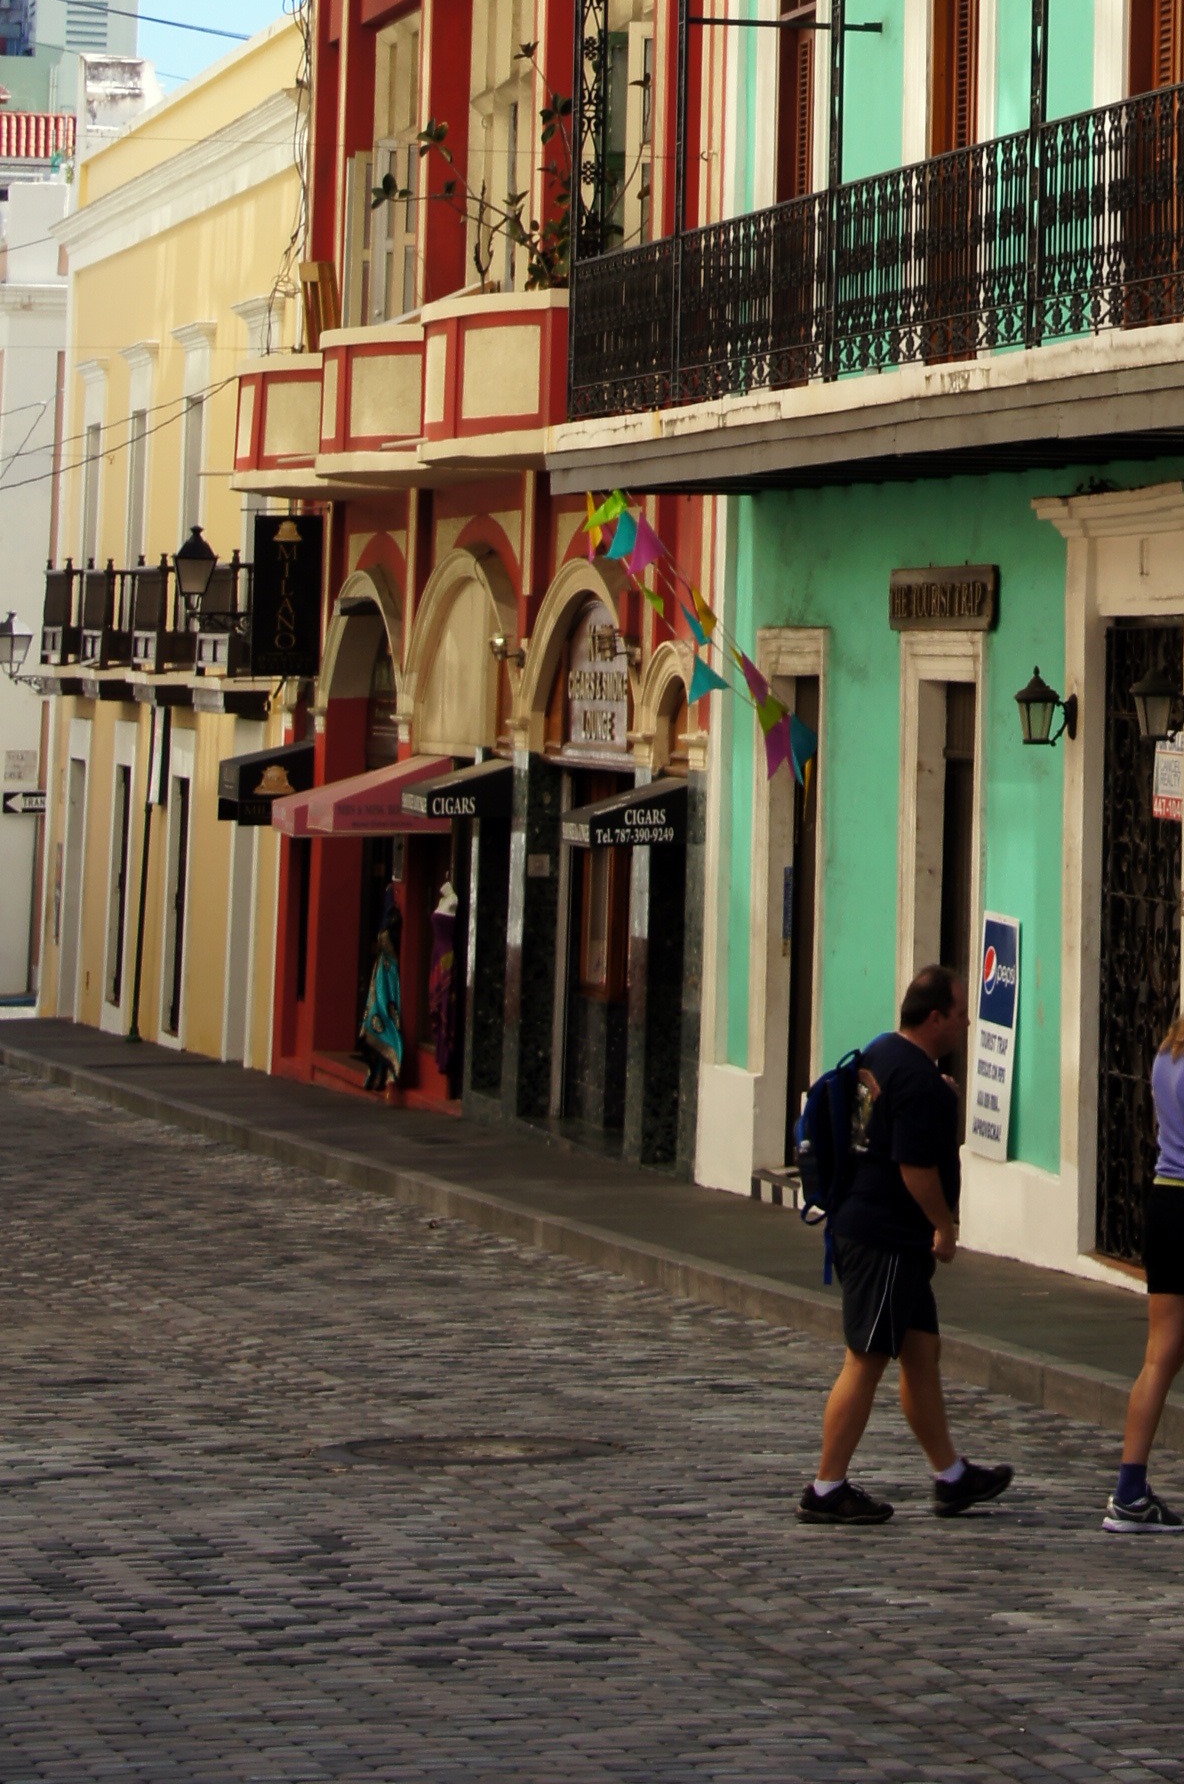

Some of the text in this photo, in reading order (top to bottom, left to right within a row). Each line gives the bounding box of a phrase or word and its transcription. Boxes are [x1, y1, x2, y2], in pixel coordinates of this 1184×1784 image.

[275, 544, 298, 649] MILANO
[911, 584, 951, 616] TOURIST
[953, 582, 982, 616] TRAP
[581, 709, 615, 741] LOUNGE
[432, 797, 476, 815] CIGARS
[624, 809, 666, 825] CIGARS
[596, 828, 613, 843] Tel.
[615, 827, 674, 843] 787-390-9249
[996, 963, 1015, 988] pepsi
